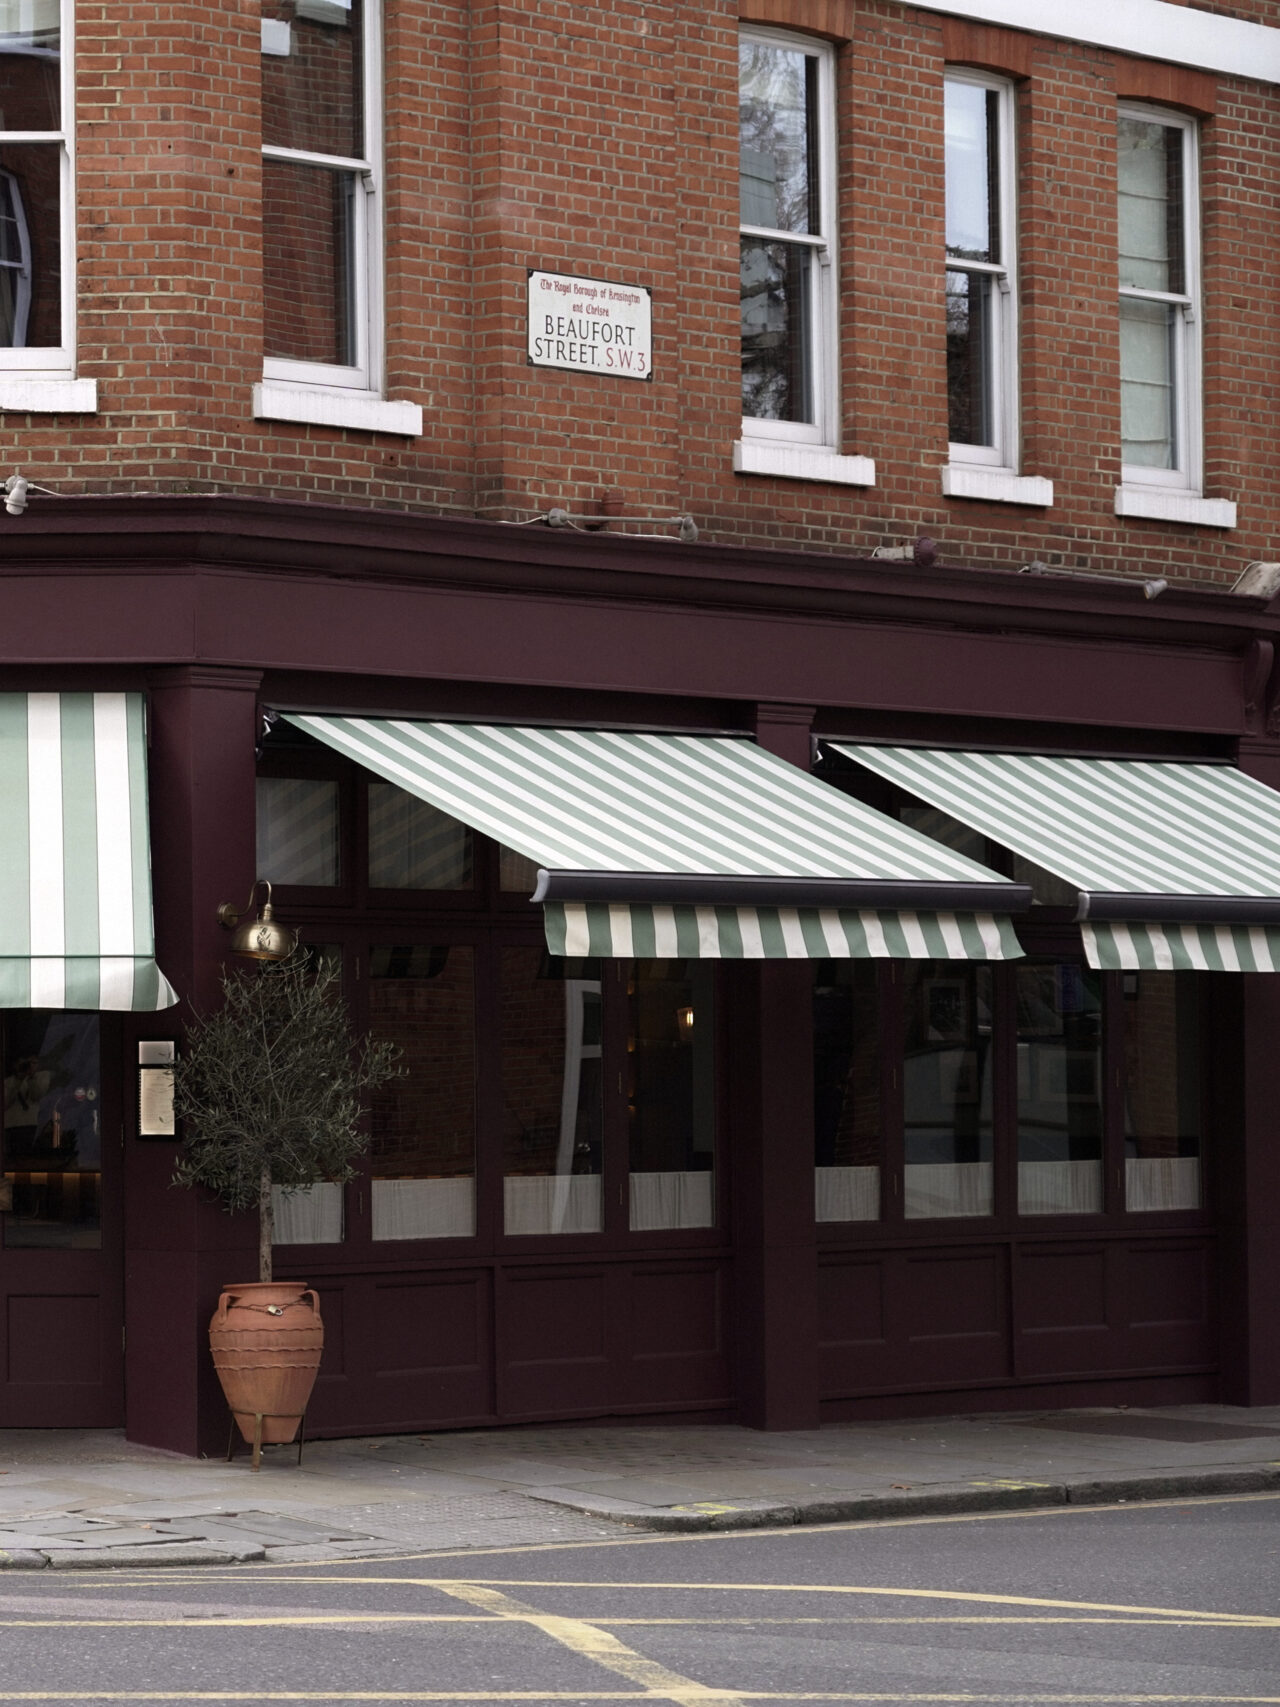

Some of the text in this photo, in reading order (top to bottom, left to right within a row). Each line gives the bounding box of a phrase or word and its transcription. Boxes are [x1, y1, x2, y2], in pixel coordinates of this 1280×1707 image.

[540, 278, 640, 306] The Royal Borough of Kensington
[572, 303, 609, 317] and Chelsea
[545, 314, 635, 346] BEAUFORT
[606, 347, 645, 372] S.W.3
